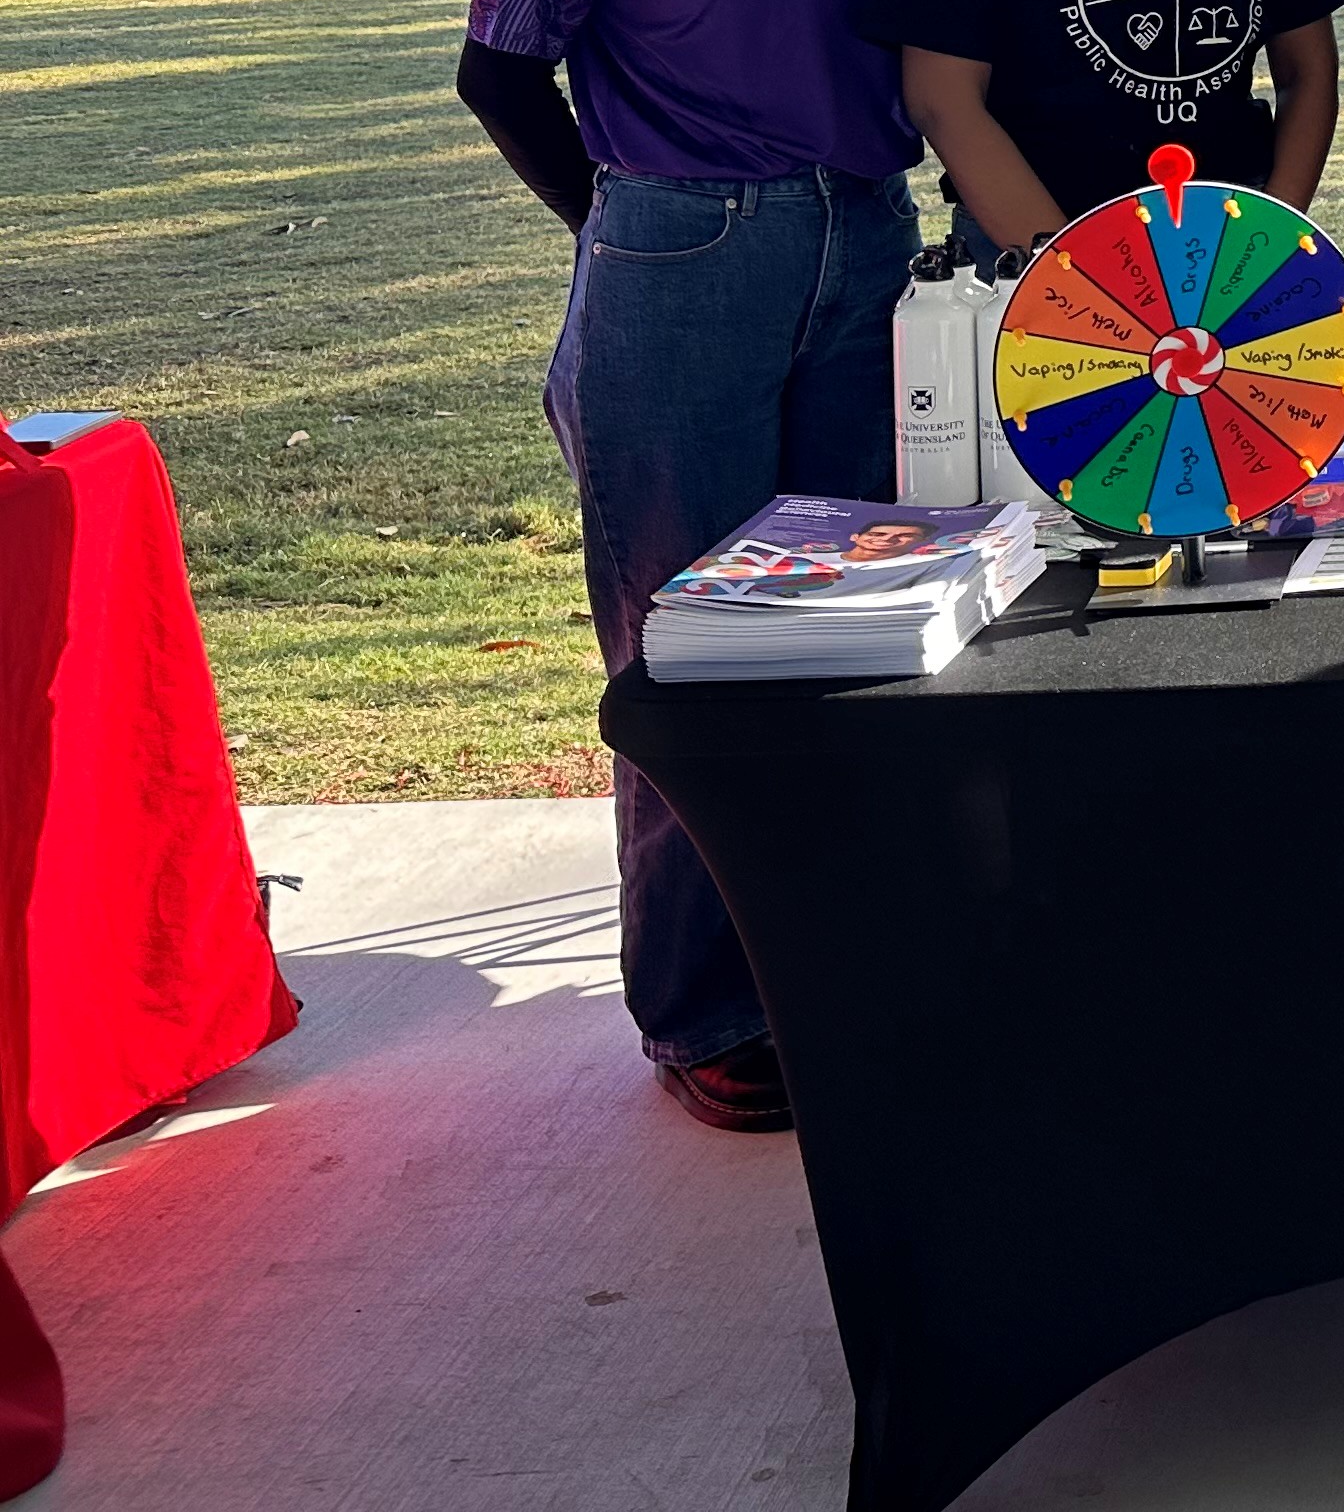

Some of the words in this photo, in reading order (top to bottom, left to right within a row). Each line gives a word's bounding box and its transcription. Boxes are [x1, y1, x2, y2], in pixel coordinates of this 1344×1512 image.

[1060, 6, 1106, 72] Public
[1108, 68, 1182, 101] Health
[1157, 101, 1197, 124] UQ
[1112, 237, 1158, 307] Alcohol
[1182, 238, 1206, 293] Drugs
[1220, 232, 1269, 295] Cannabis
[1247, 278, 1322, 322] Cocaine
[901, 432, 965, 444] QUEENSLAND
[905, 420, 964, 431] UNIVERSITY
[1223, 418, 1272, 473] Alcohol
[1176, 446, 1198, 496] Drugs
[685, 539, 791, 596] 2027
